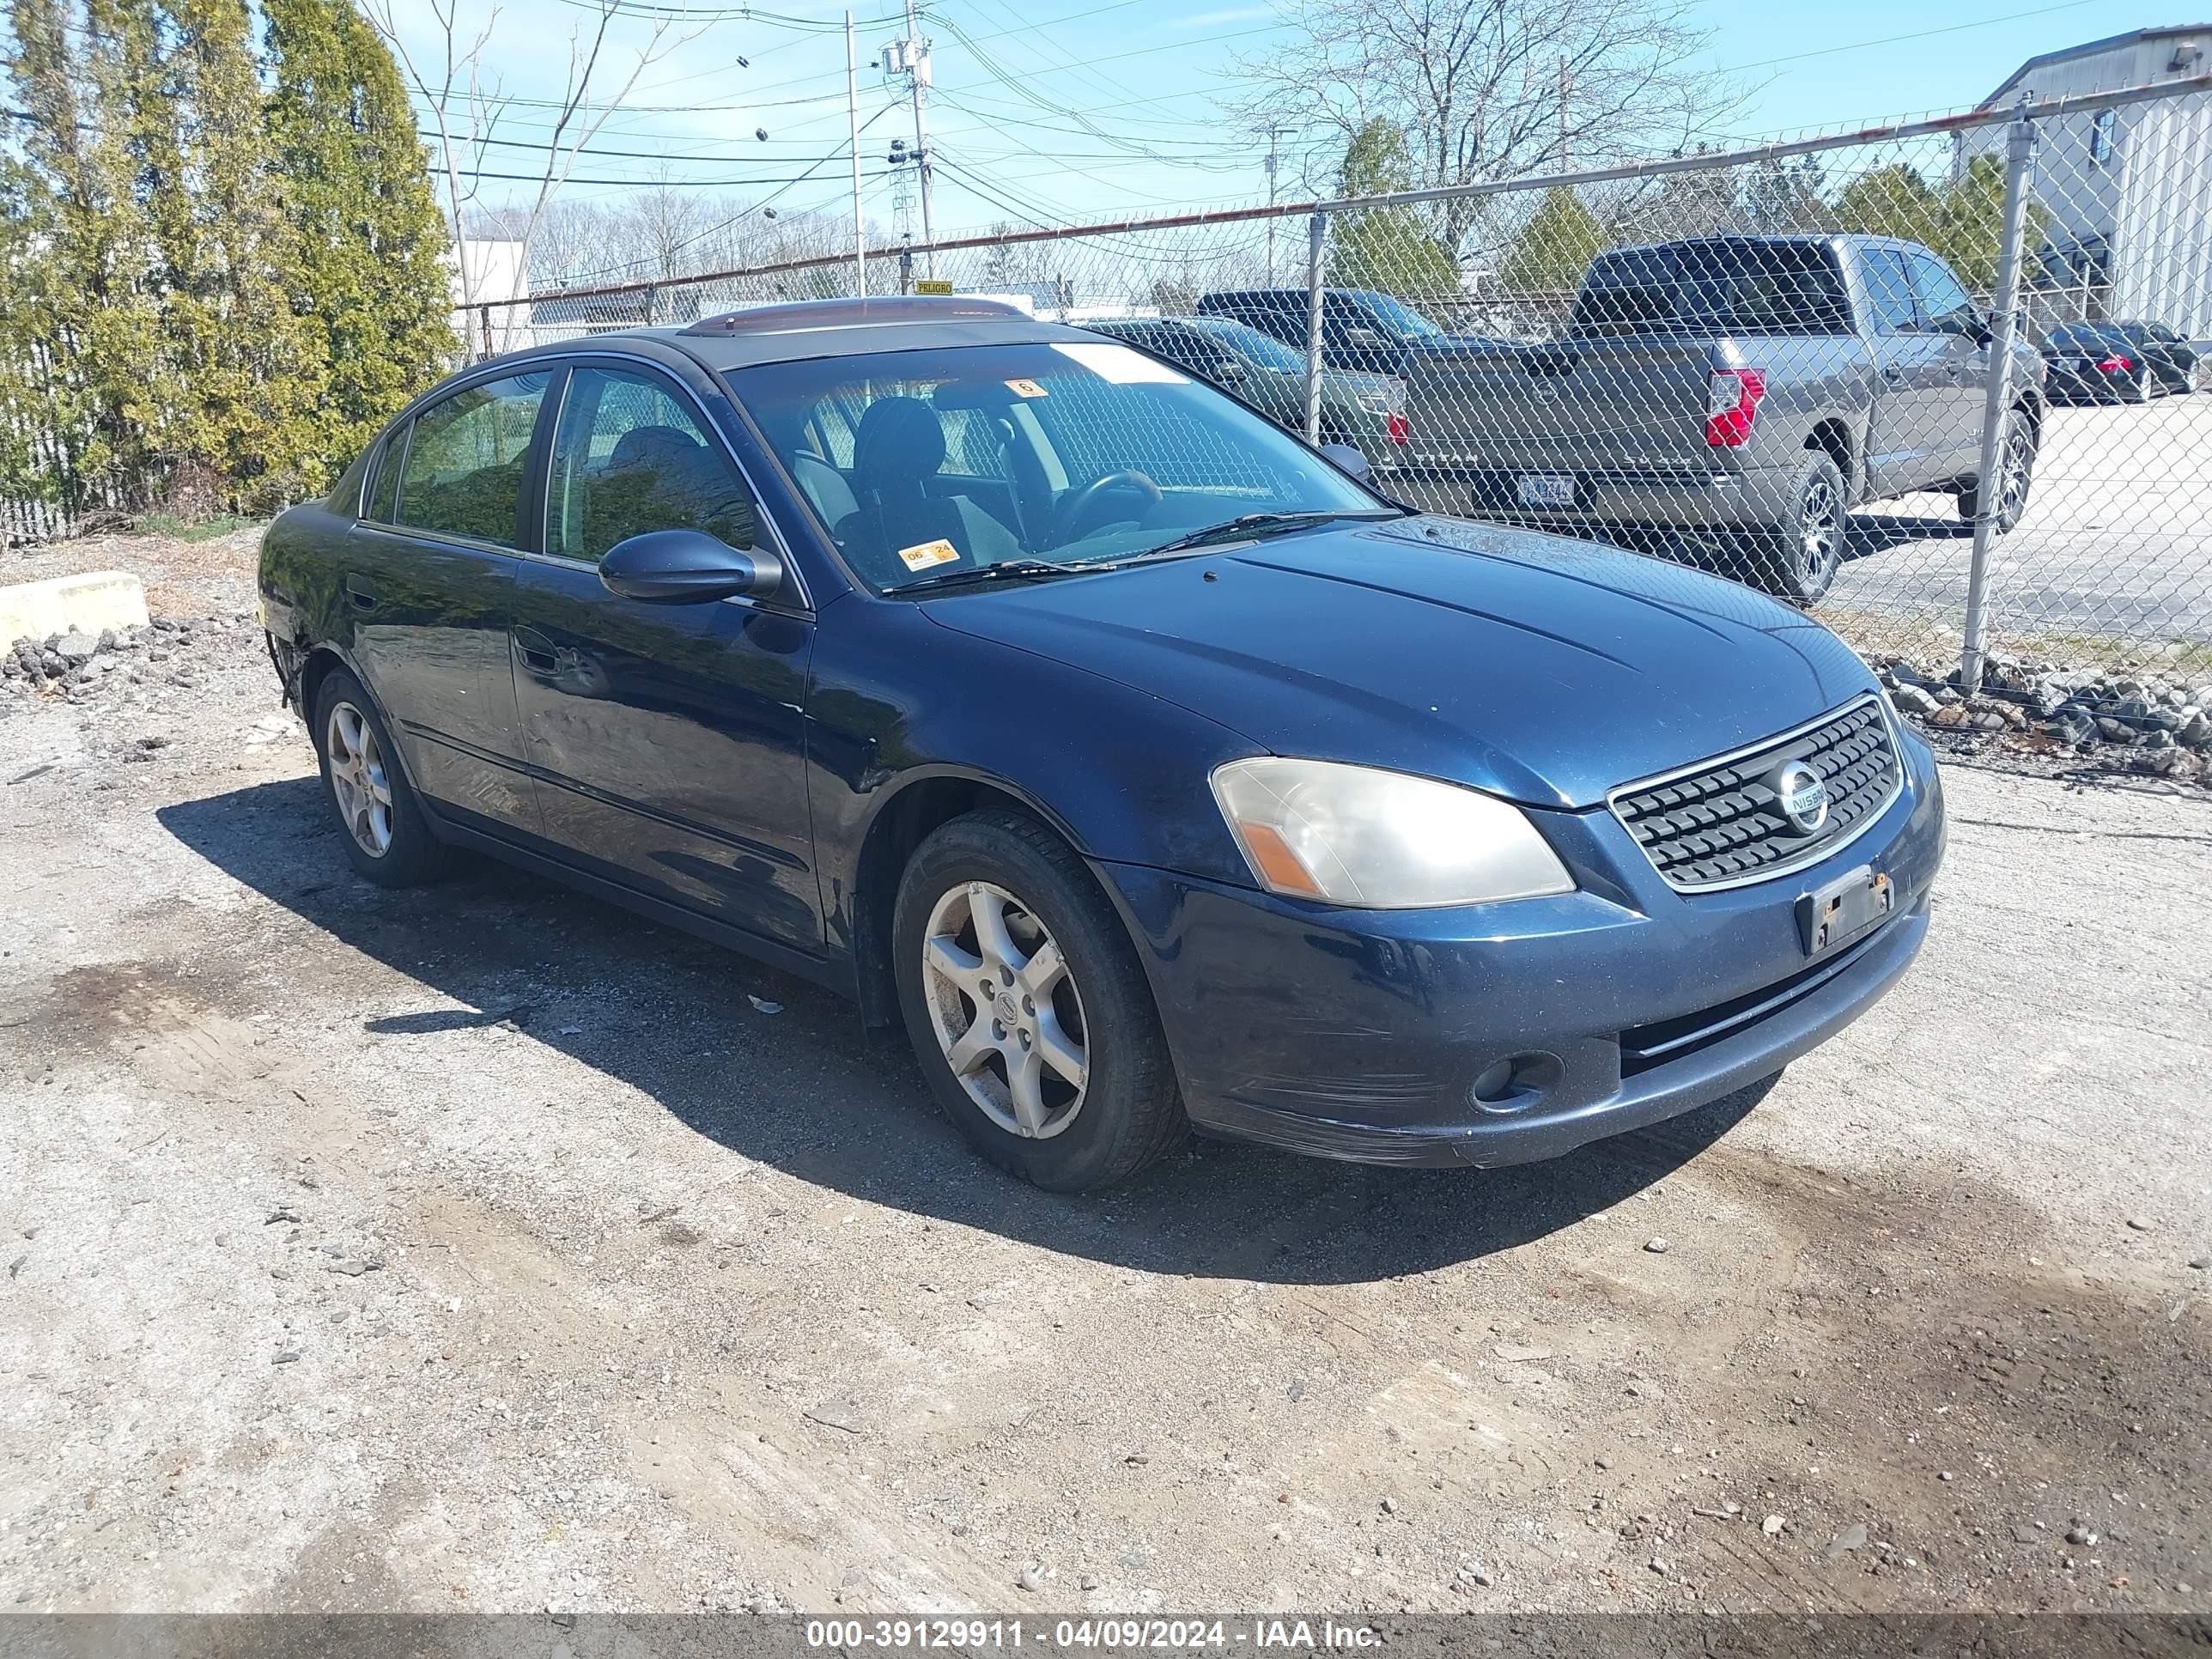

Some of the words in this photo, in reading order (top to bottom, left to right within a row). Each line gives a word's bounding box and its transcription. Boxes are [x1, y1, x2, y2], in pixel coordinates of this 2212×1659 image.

[919, 283, 951, 293] PELIGRO
[1018, 383, 1034, 392] 6
[908, 551, 923, 561] 06
[935, 544, 951, 553] 24
